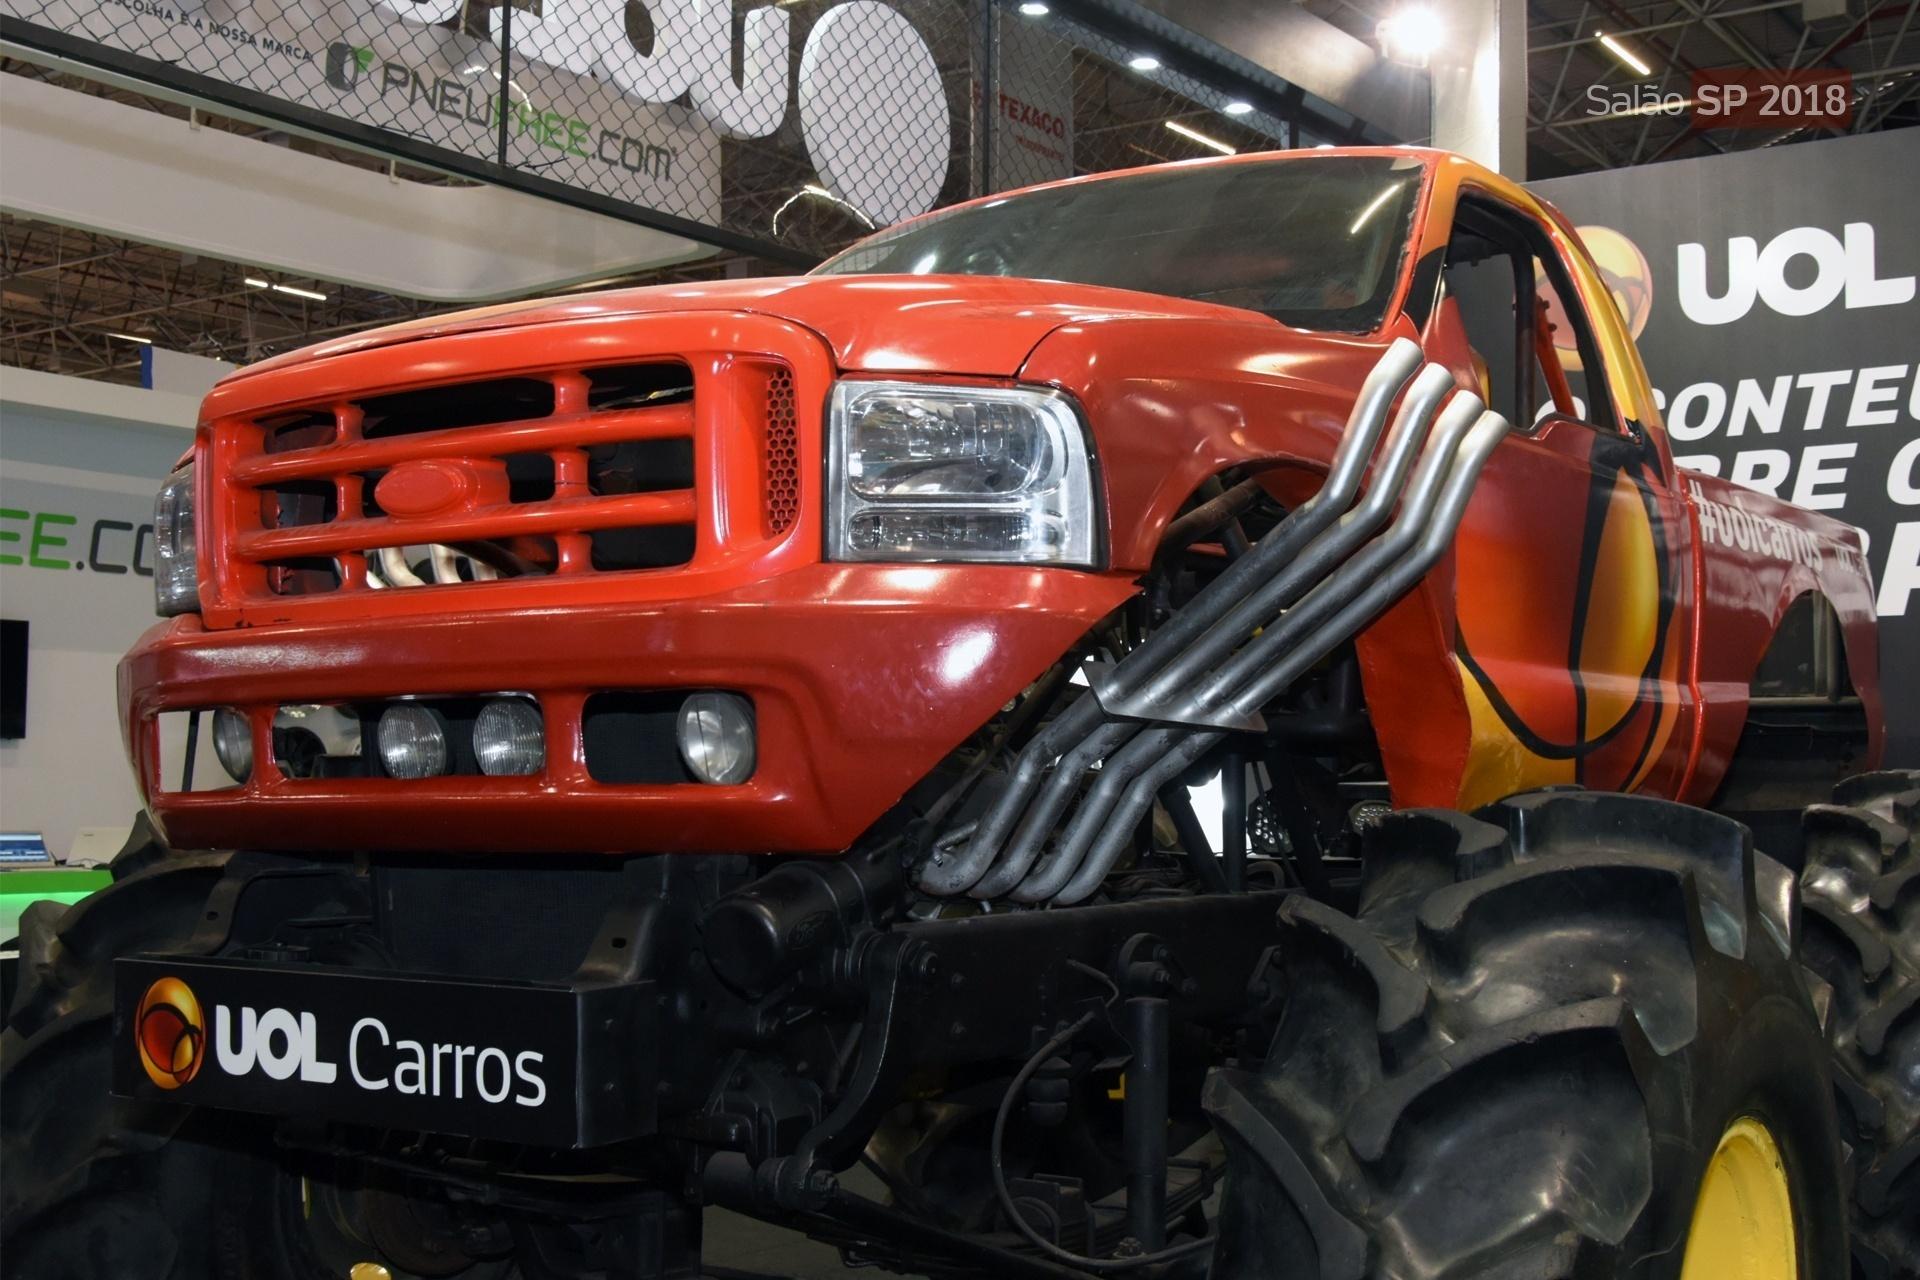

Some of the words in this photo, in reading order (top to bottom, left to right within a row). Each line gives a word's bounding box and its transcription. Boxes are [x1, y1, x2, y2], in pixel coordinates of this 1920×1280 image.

[193, 18, 203, 30] A
[209, 22, 258, 46] NOSSA
[262, 38, 313, 62] MARCA
[996, 87, 1065, 140] TEXACO
[1677, 221, 1917, 325] UOL
[1652, 364, 1920, 441] ONTE
[215, 1004, 337, 1084] UOL
[349, 1017, 547, 1107] Carros
